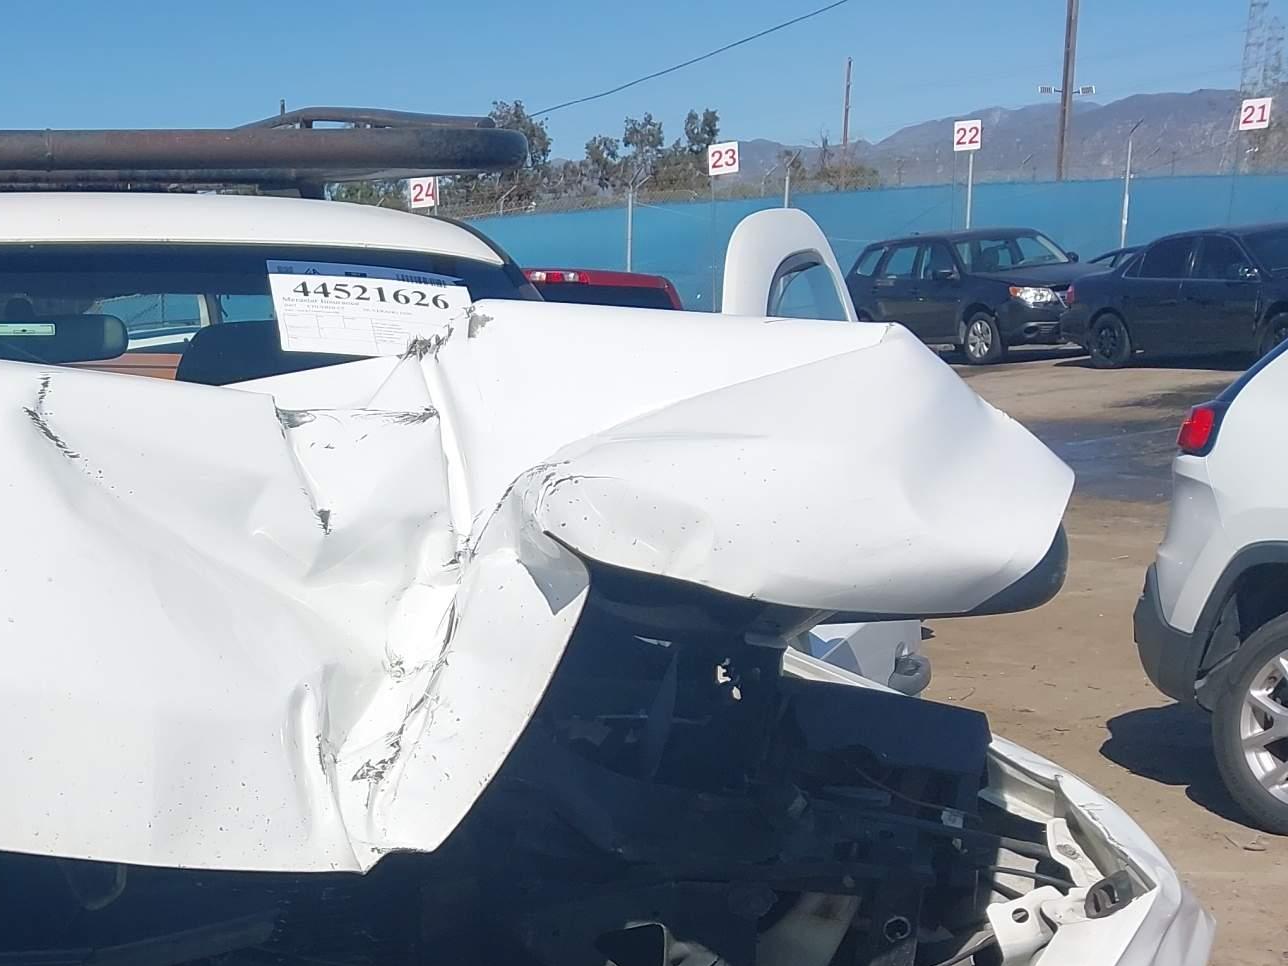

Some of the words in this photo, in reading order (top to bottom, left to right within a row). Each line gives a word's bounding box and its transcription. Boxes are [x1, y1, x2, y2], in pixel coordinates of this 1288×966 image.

[1242, 104, 1268, 125] 21
[956, 126, 980, 146] 22
[711, 148, 736, 169] 23
[413, 182, 435, 203] 24
[293, 281, 450, 310] 44521626
